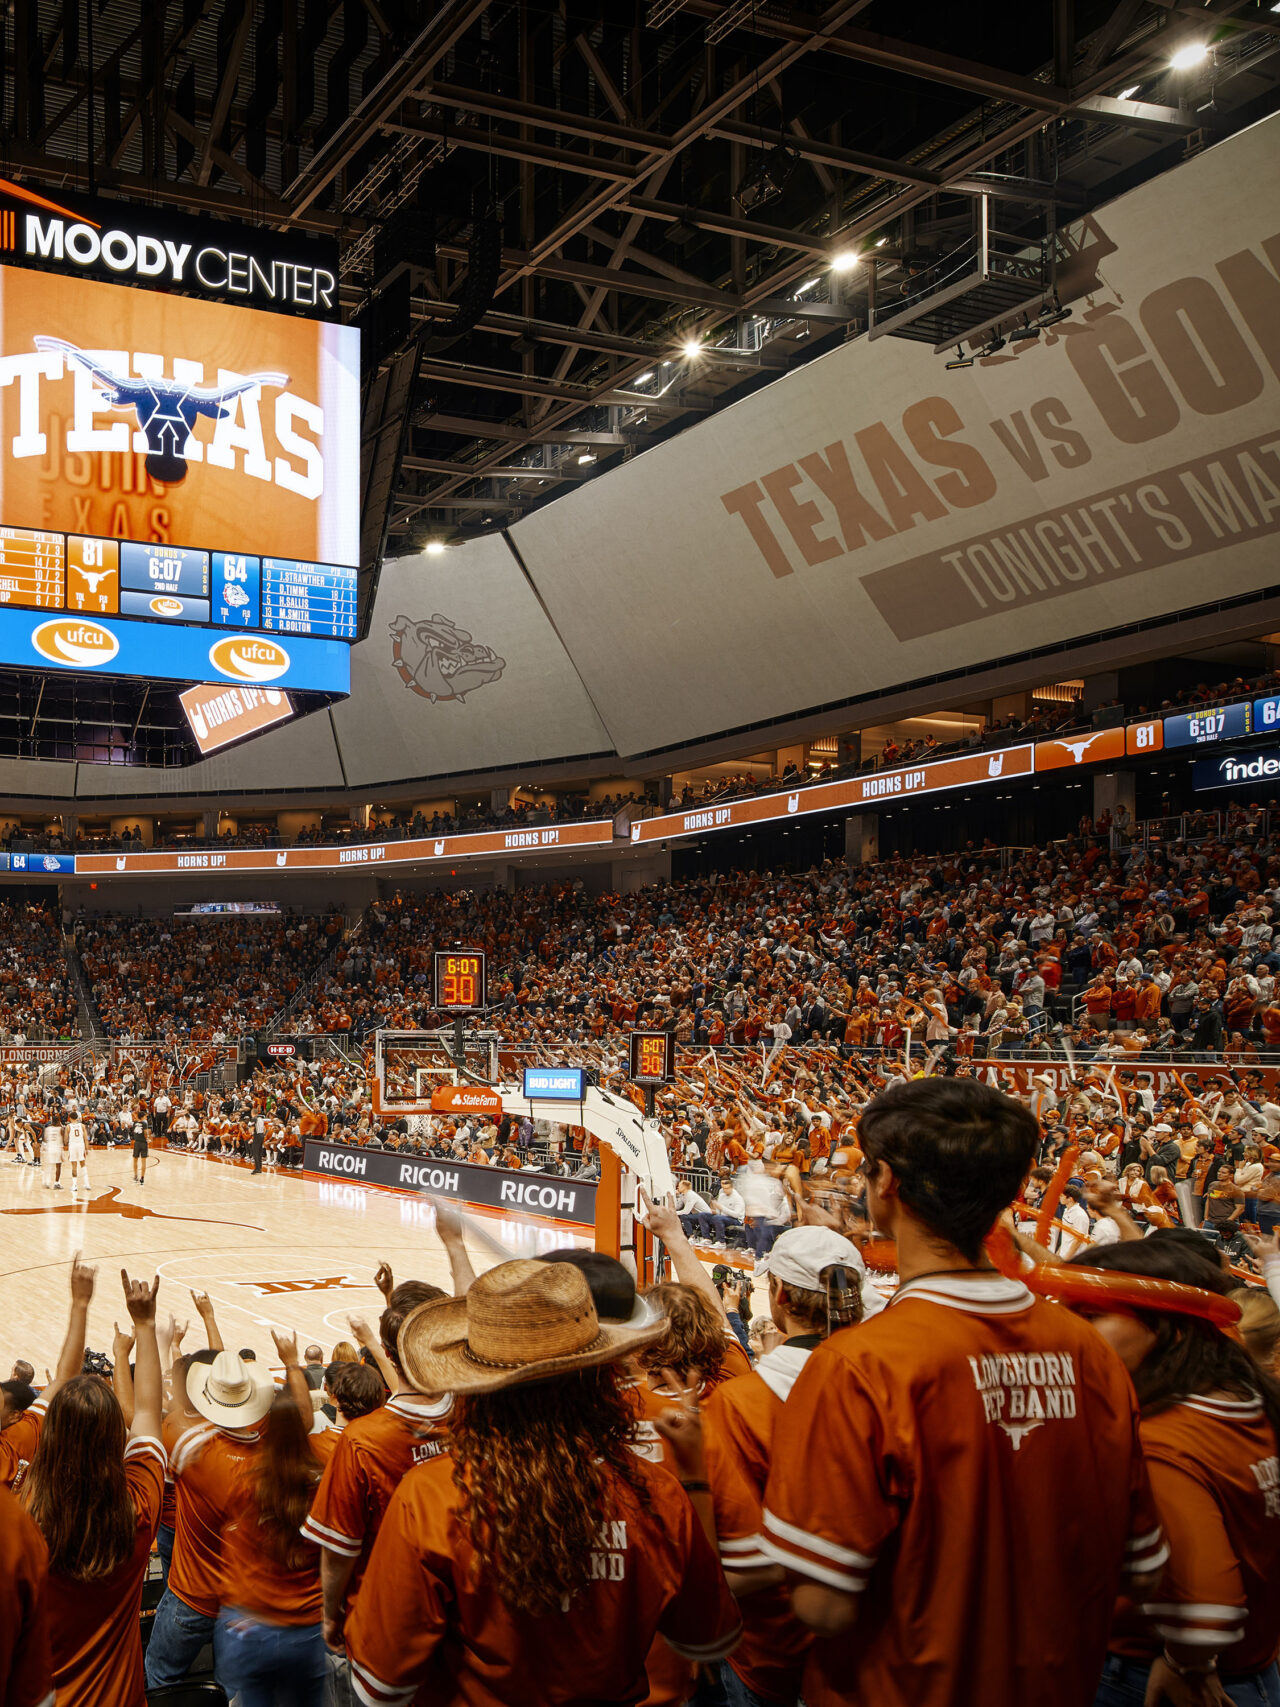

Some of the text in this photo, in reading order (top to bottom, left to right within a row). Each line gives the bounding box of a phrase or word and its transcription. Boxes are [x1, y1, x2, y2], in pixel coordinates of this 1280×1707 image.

[26, 214, 336, 309] MOODY CENTER
[720, 396, 998, 579] TEXAS
[989, 397, 1093, 483] VS
[36, 543, 41, 554] 2
[82, 539, 103, 567] 81
[941, 484, 1192, 609] TONIGHT'S
[34, 556, 43, 567] 14
[149, 557, 182, 581] 6:07
[223, 555, 248, 583] 64
[279, 572, 325, 586] J.STRAWTHER
[279, 584, 309, 597] D.TIMME
[279, 596, 309, 609] H.SALLIS
[279, 608, 310, 621] M.SMITH
[67, 626, 104, 646] ufcu
[279, 620, 311, 633] R.BOLTON
[241, 643, 276, 663] ufcu
[202, 688, 245, 728] HORNS
[1136, 714, 1225, 748] 81 6:07
[1224, 756, 1280, 781] inde
[862, 770, 925, 798] HORNS UP!
[684, 808, 731, 830] HORNS UP!
[505, 830, 559, 847] HORNS UP!
[13, 856, 25, 868] 64
[178, 855, 226, 867] HORNS UP!
[340, 847, 385, 863] HORNS UP!
[448, 959, 478, 974] 6:07
[444, 975, 474, 1003] 30
[643, 1039, 665, 1053] 6:07
[642, 1055, 660, 1074] 30
[529, 1077, 577, 1089] BUD LIGHT
[615, 1127, 641, 1158] SPALDING
[318, 1150, 367, 1176] RICOH
[399, 1163, 460, 1192] RICOH
[500, 1179, 576, 1213] RICOH
[966, 1351, 1076, 1390] LONGHORN
[981, 1385, 1077, 1424] PEP BAND
